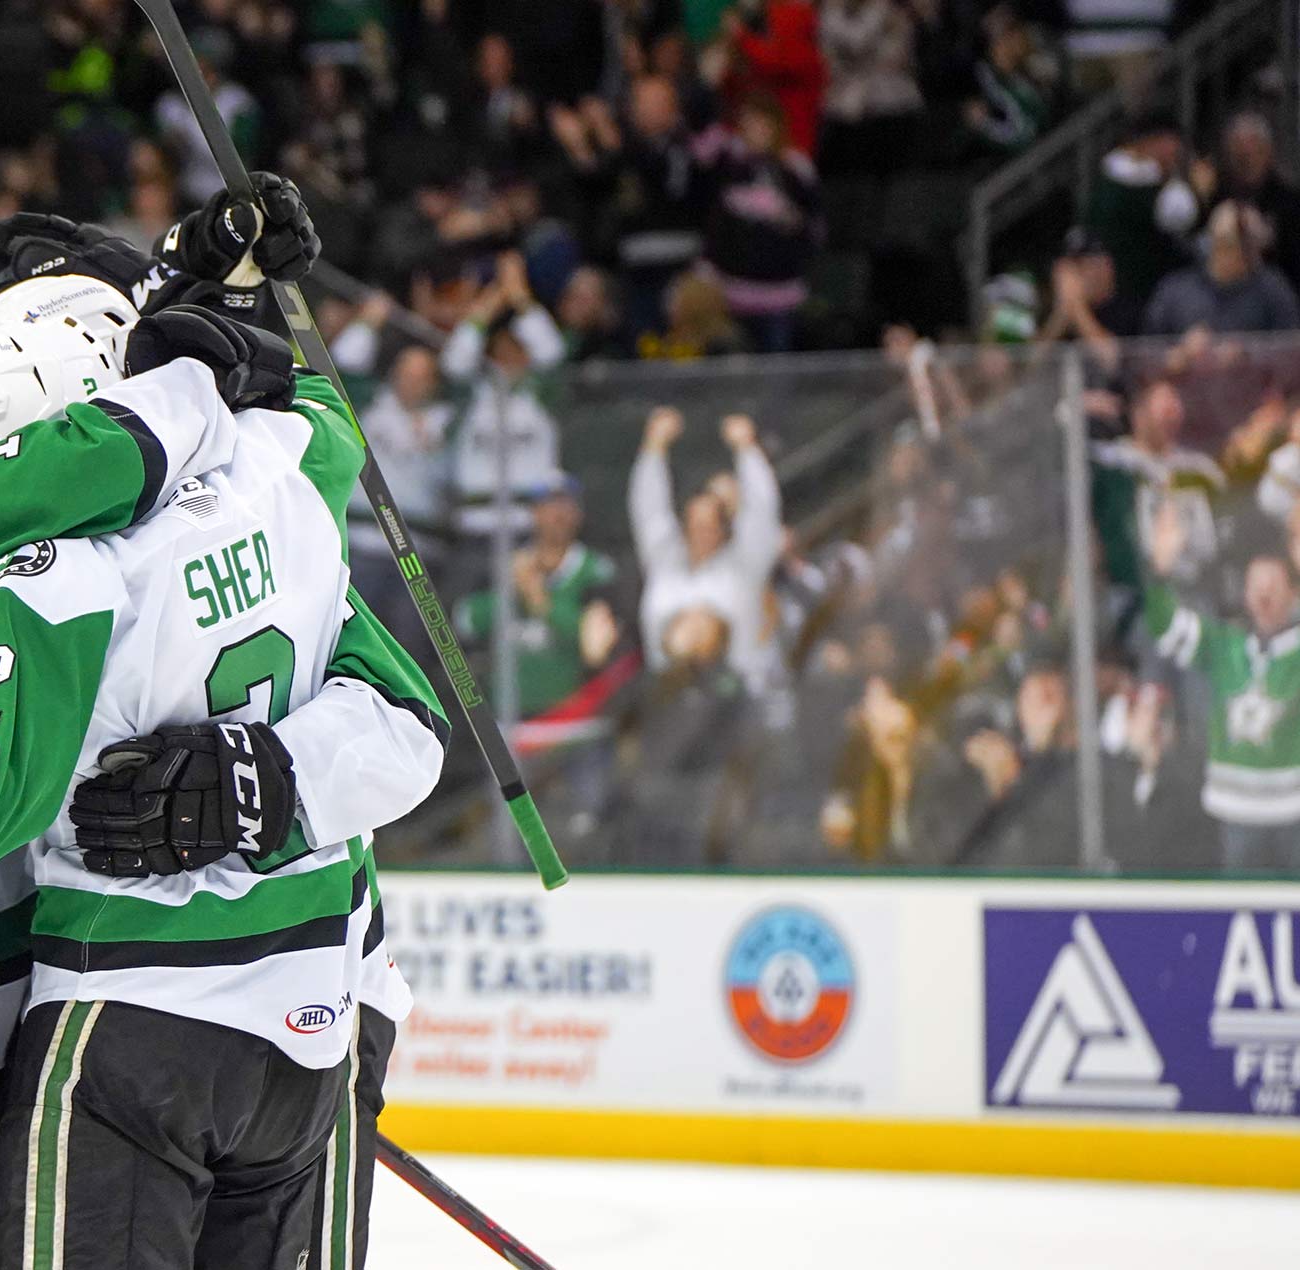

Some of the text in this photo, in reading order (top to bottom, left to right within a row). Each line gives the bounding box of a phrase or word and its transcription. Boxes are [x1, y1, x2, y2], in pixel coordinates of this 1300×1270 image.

[381, 508, 407, 552] TRIGGER
[183, 529, 277, 630] SHEA
[218, 723, 265, 853] CCM
[295, 1010, 328, 1028] AHL
